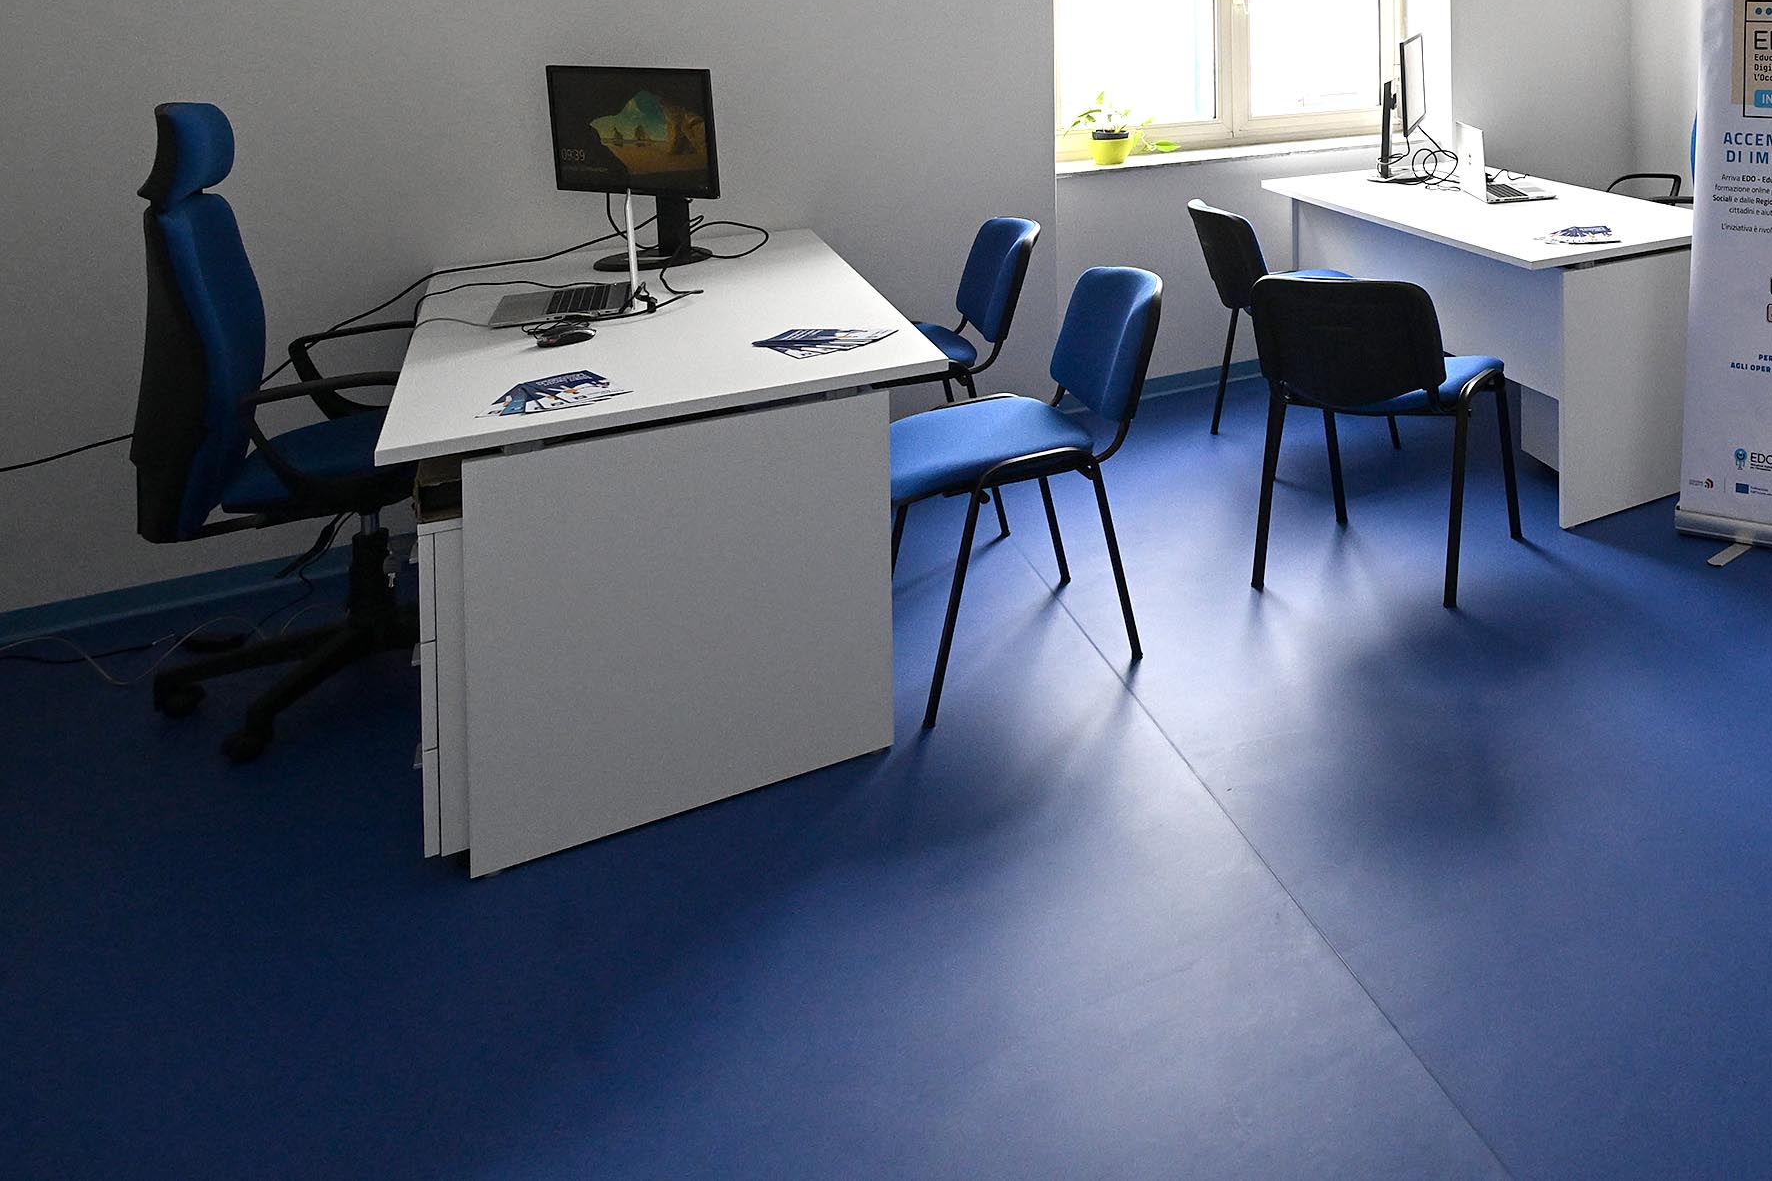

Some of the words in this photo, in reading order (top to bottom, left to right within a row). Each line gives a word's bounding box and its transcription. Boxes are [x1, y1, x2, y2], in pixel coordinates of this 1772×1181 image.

[1726, 150, 1742, 163] DI
[1721, 174, 1740, 182] Arriva
[1715, 183, 1750, 193] formazione
[1751, 186, 1770, 195] online
[1712, 194, 1732, 202] Sociali
[1728, 207, 1755, 215] cittadini
[1721, 223, 1752, 232] L'iniziativa
[1730, 362, 1748, 370] AGLI
